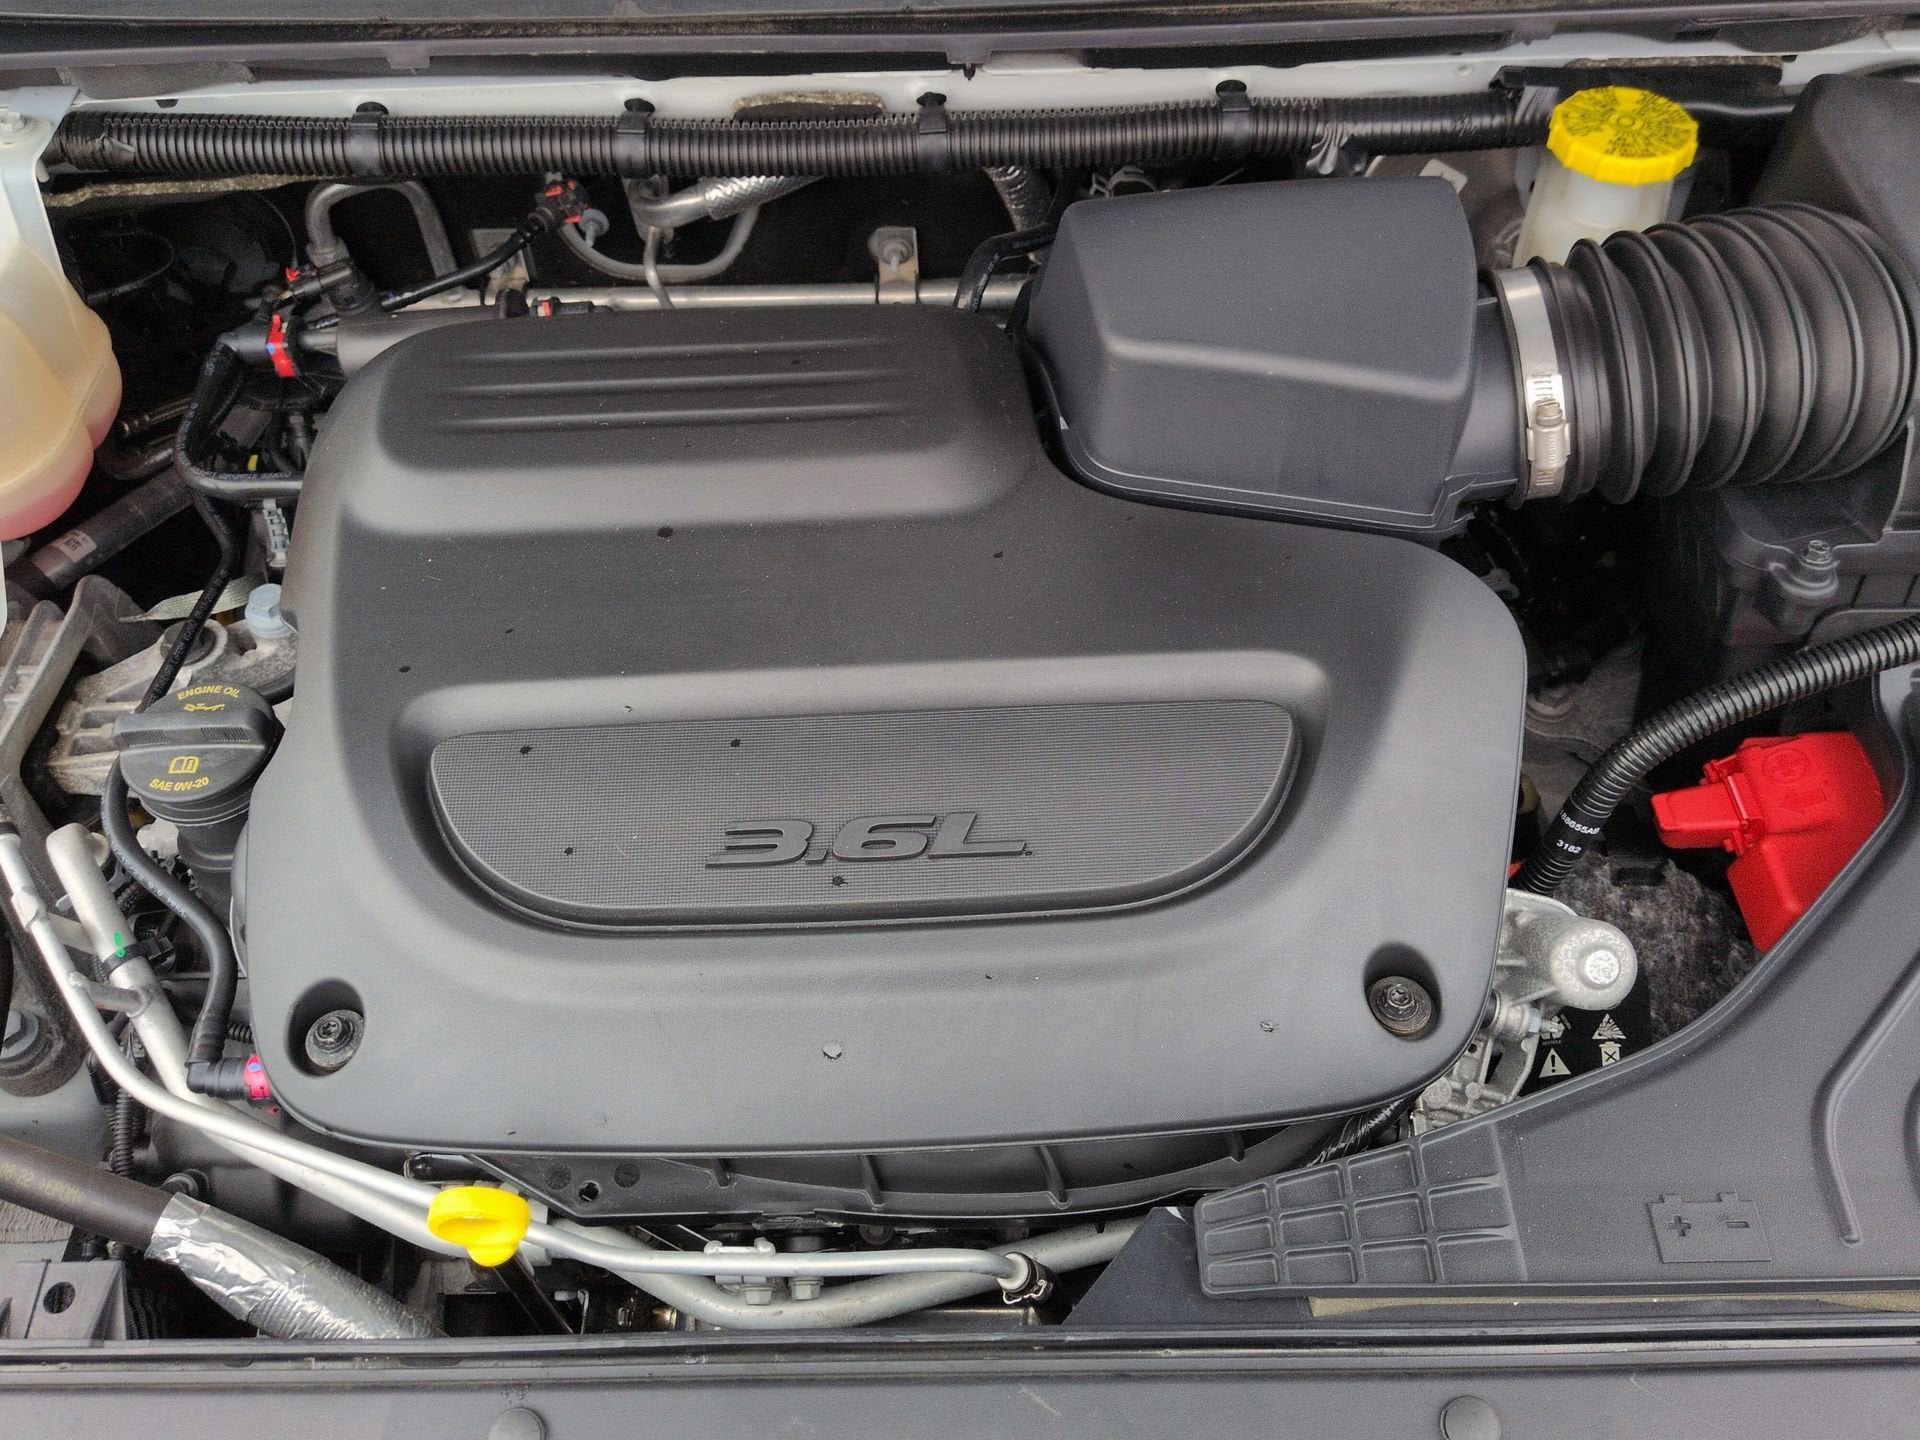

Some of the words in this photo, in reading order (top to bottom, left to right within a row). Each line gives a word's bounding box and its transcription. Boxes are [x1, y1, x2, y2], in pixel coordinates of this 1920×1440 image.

[176, 685, 222, 700] ENGINE
[223, 686, 242, 699] OIL
[150, 778, 173, 791] SAE
[174, 776, 210, 792] 0W-20
[704, 811, 1027, 869] 3.6L
